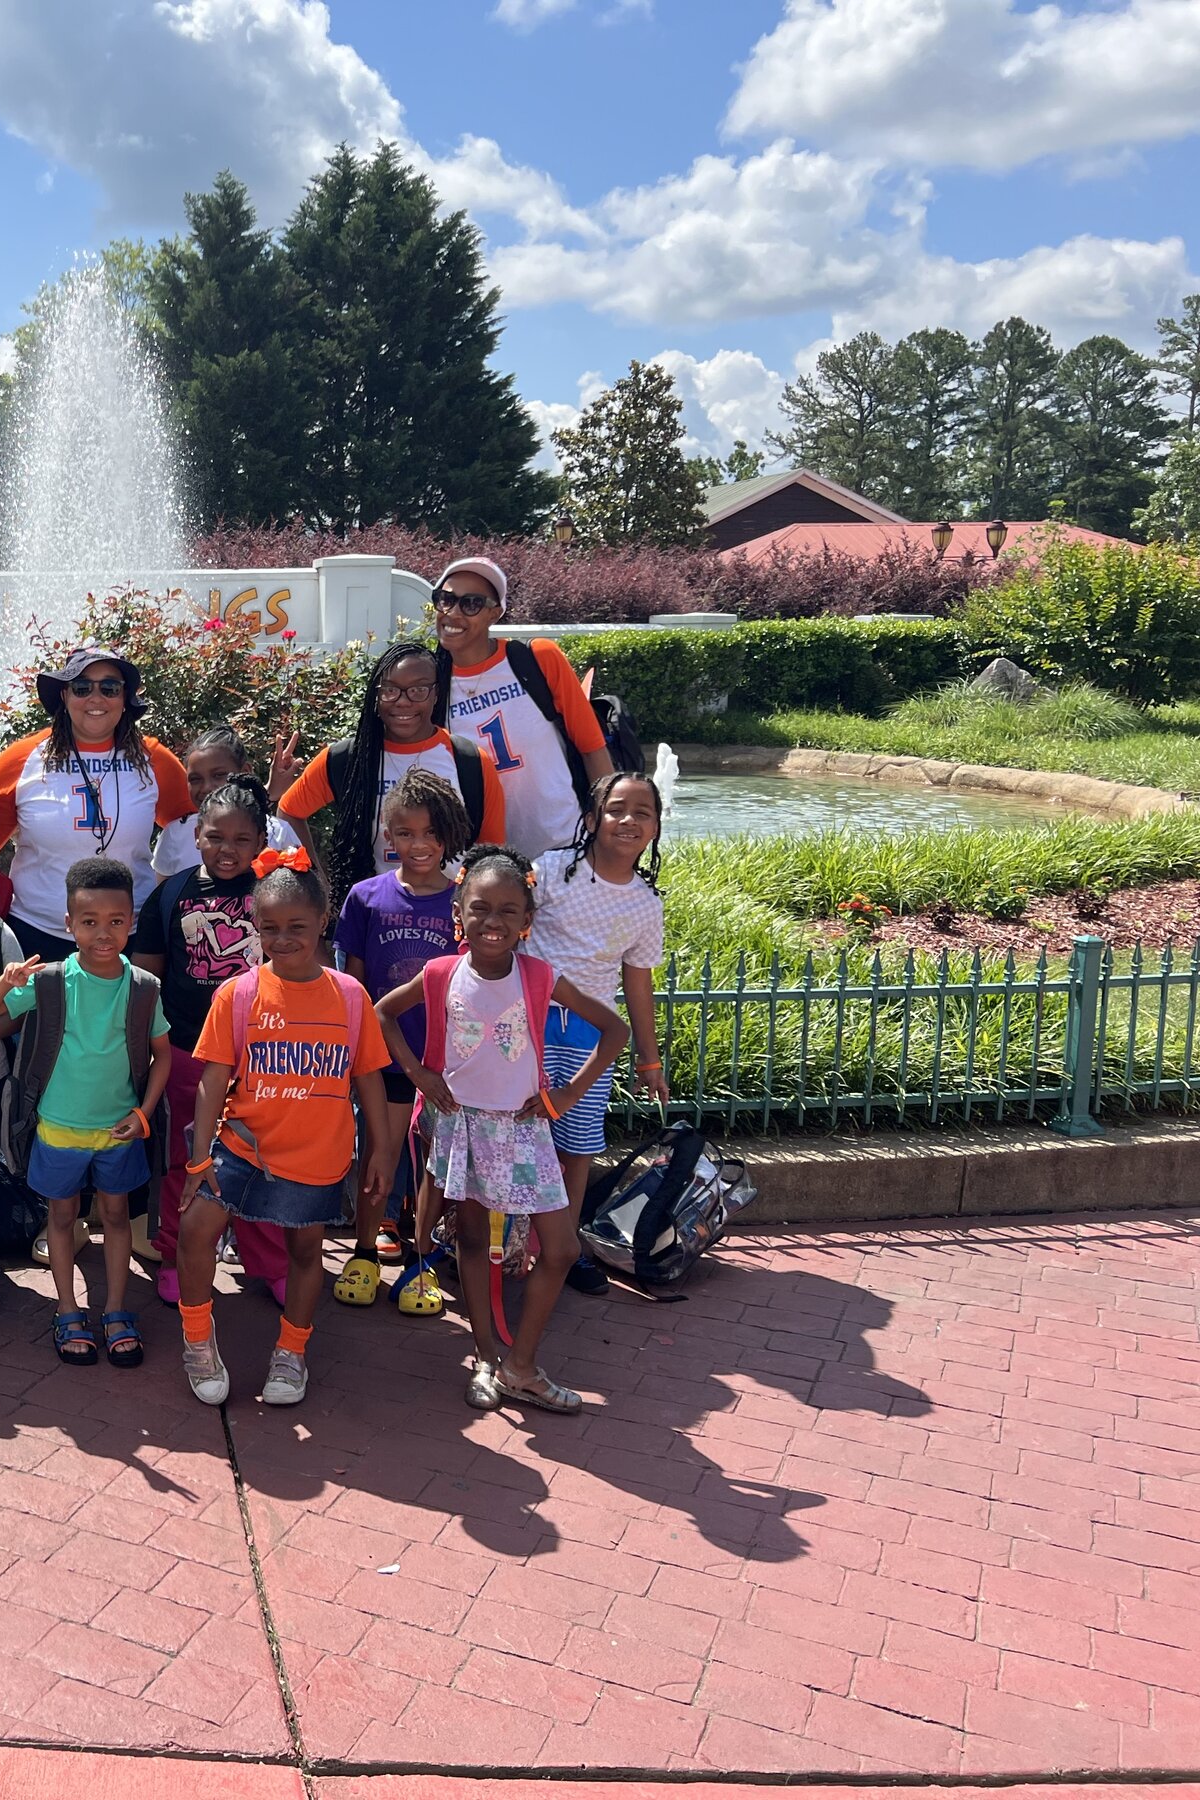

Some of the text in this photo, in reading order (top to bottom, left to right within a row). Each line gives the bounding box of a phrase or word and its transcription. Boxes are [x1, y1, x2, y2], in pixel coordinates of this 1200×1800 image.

[450, 682, 527, 719] FRIENDSH
[476, 710, 525, 774] 1
[380, 912, 452, 933] THIS GIRL
[378, 927, 448, 950] LOVES HER
[257, 1012, 286, 1030] It's
[247, 1041, 350, 1079] FRIENDSHIP
[255, 1080, 315, 1103] for me!
